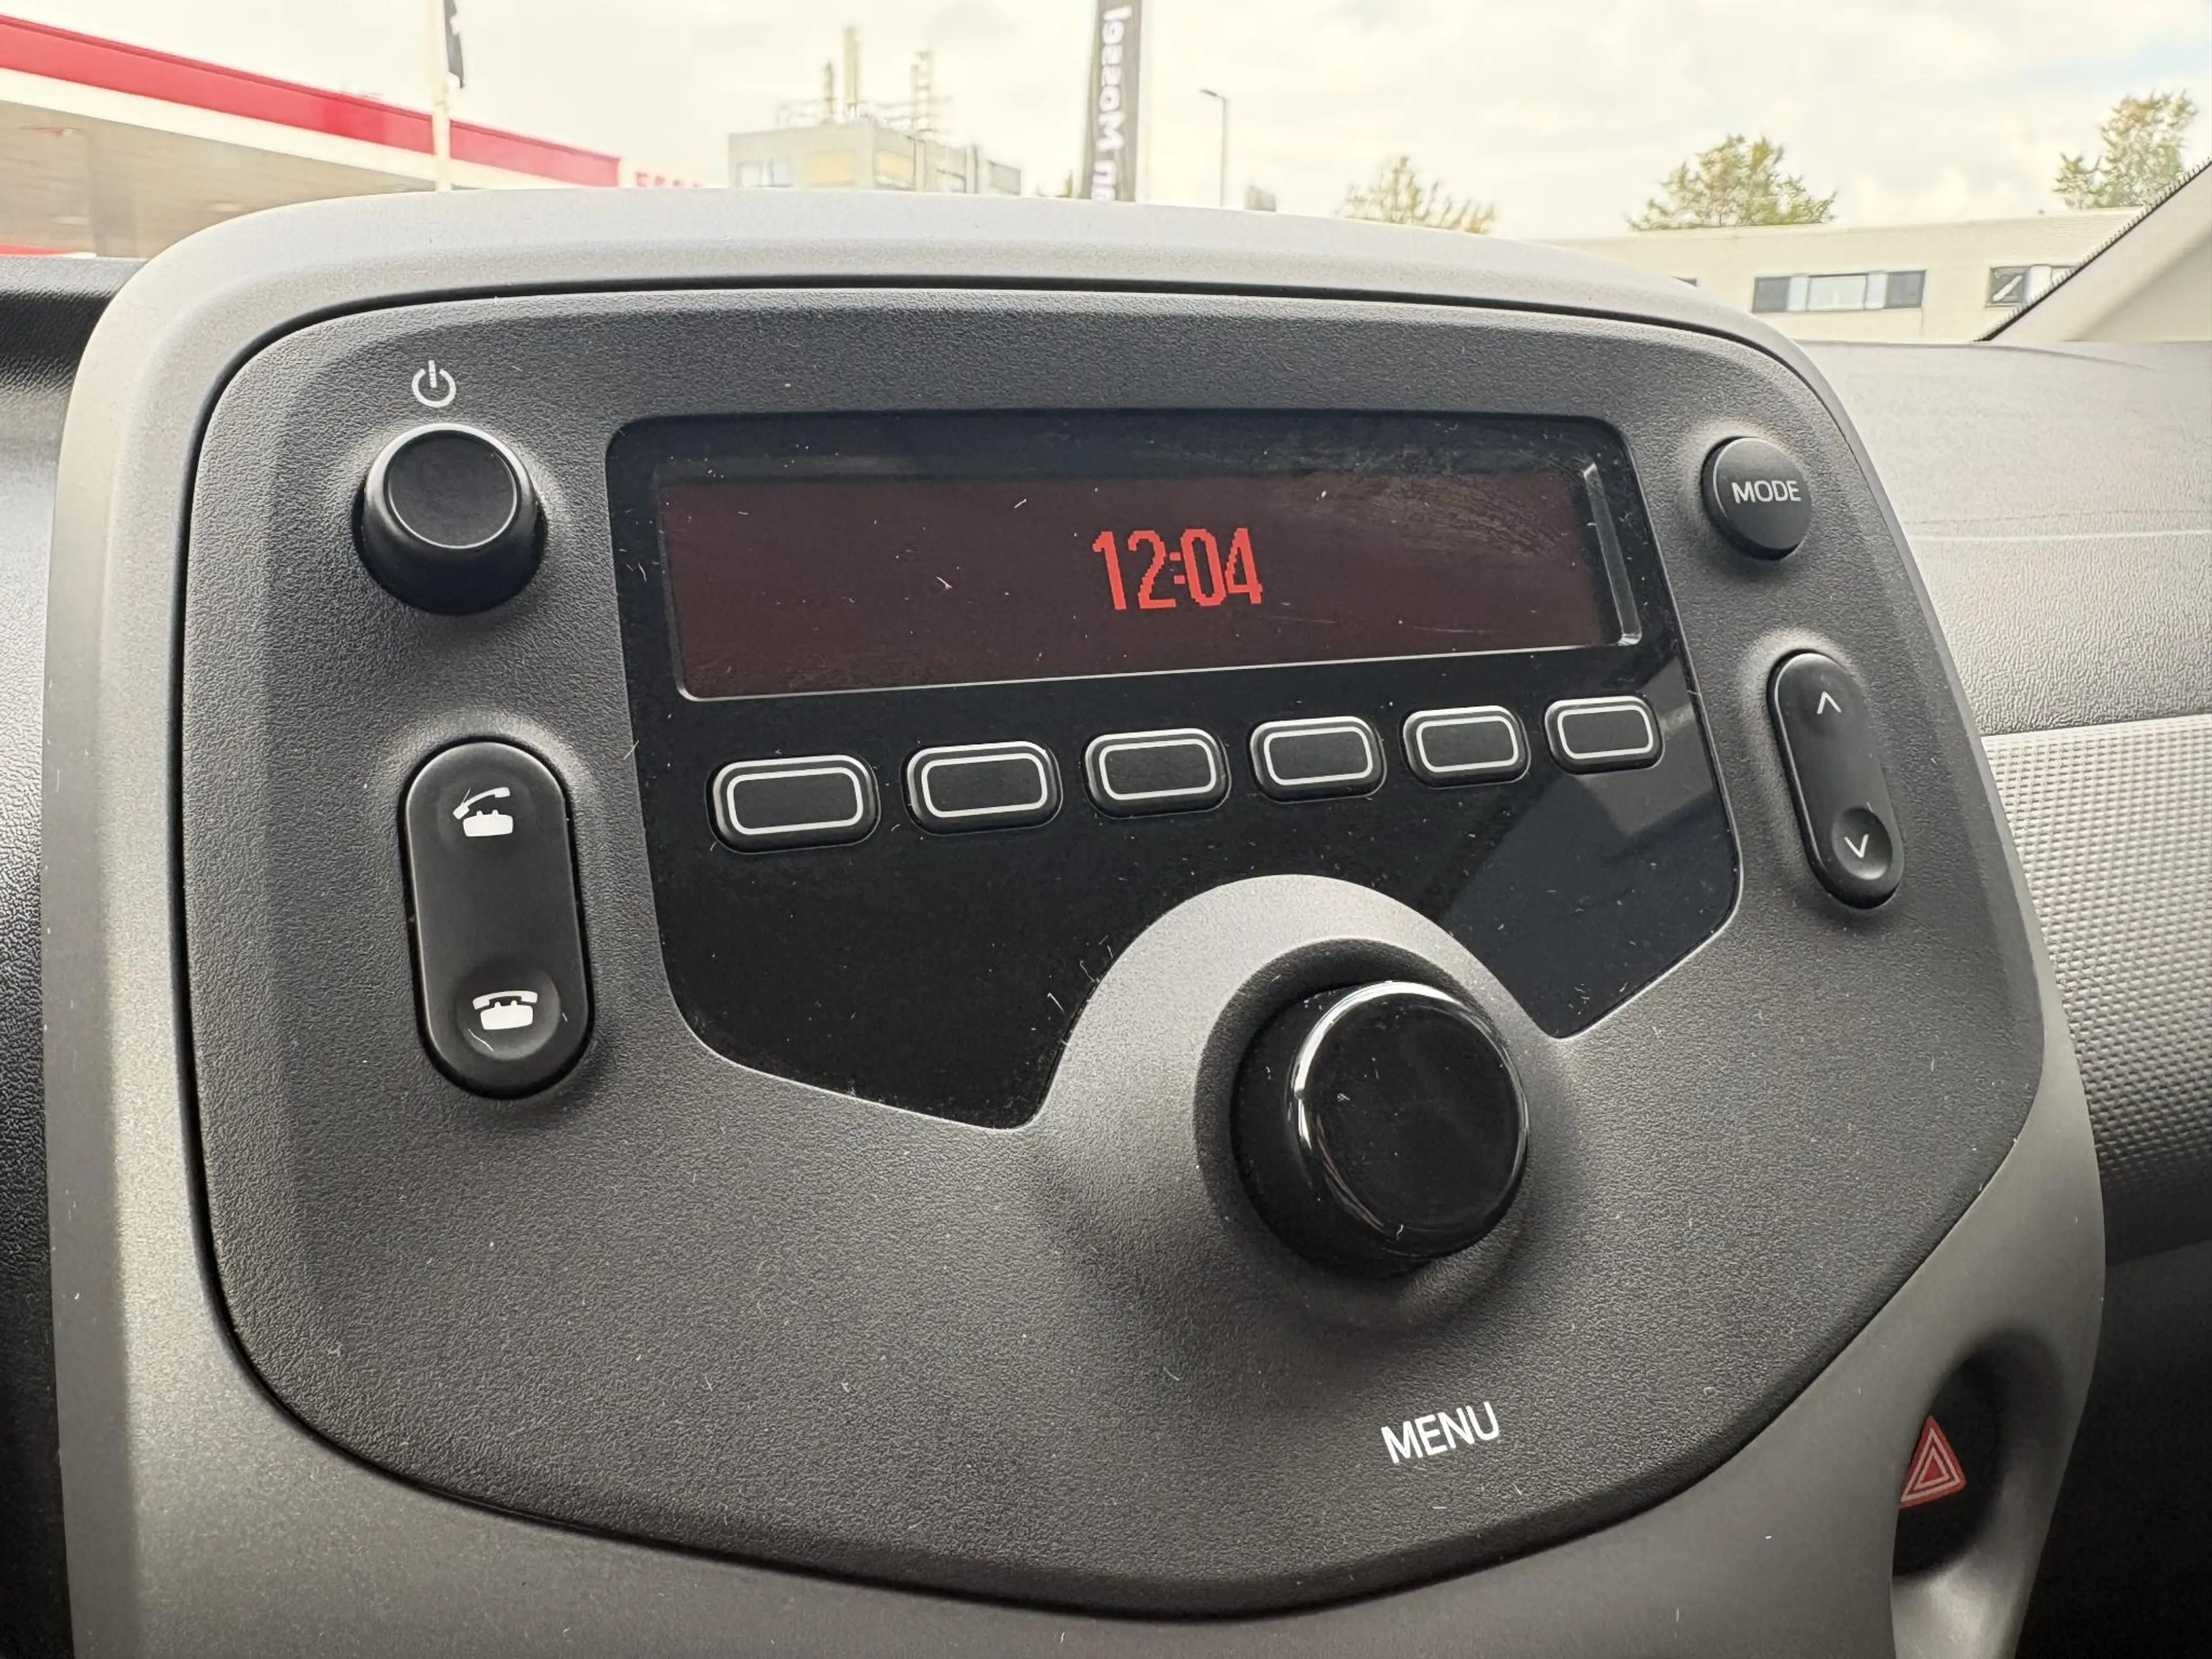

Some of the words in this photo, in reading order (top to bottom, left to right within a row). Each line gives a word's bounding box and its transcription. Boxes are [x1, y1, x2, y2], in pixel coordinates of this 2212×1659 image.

[1731, 480, 1802, 504] MODE
[1092, 527, 1263, 610] 12:04
[1381, 1400, 1499, 1464] MENU
